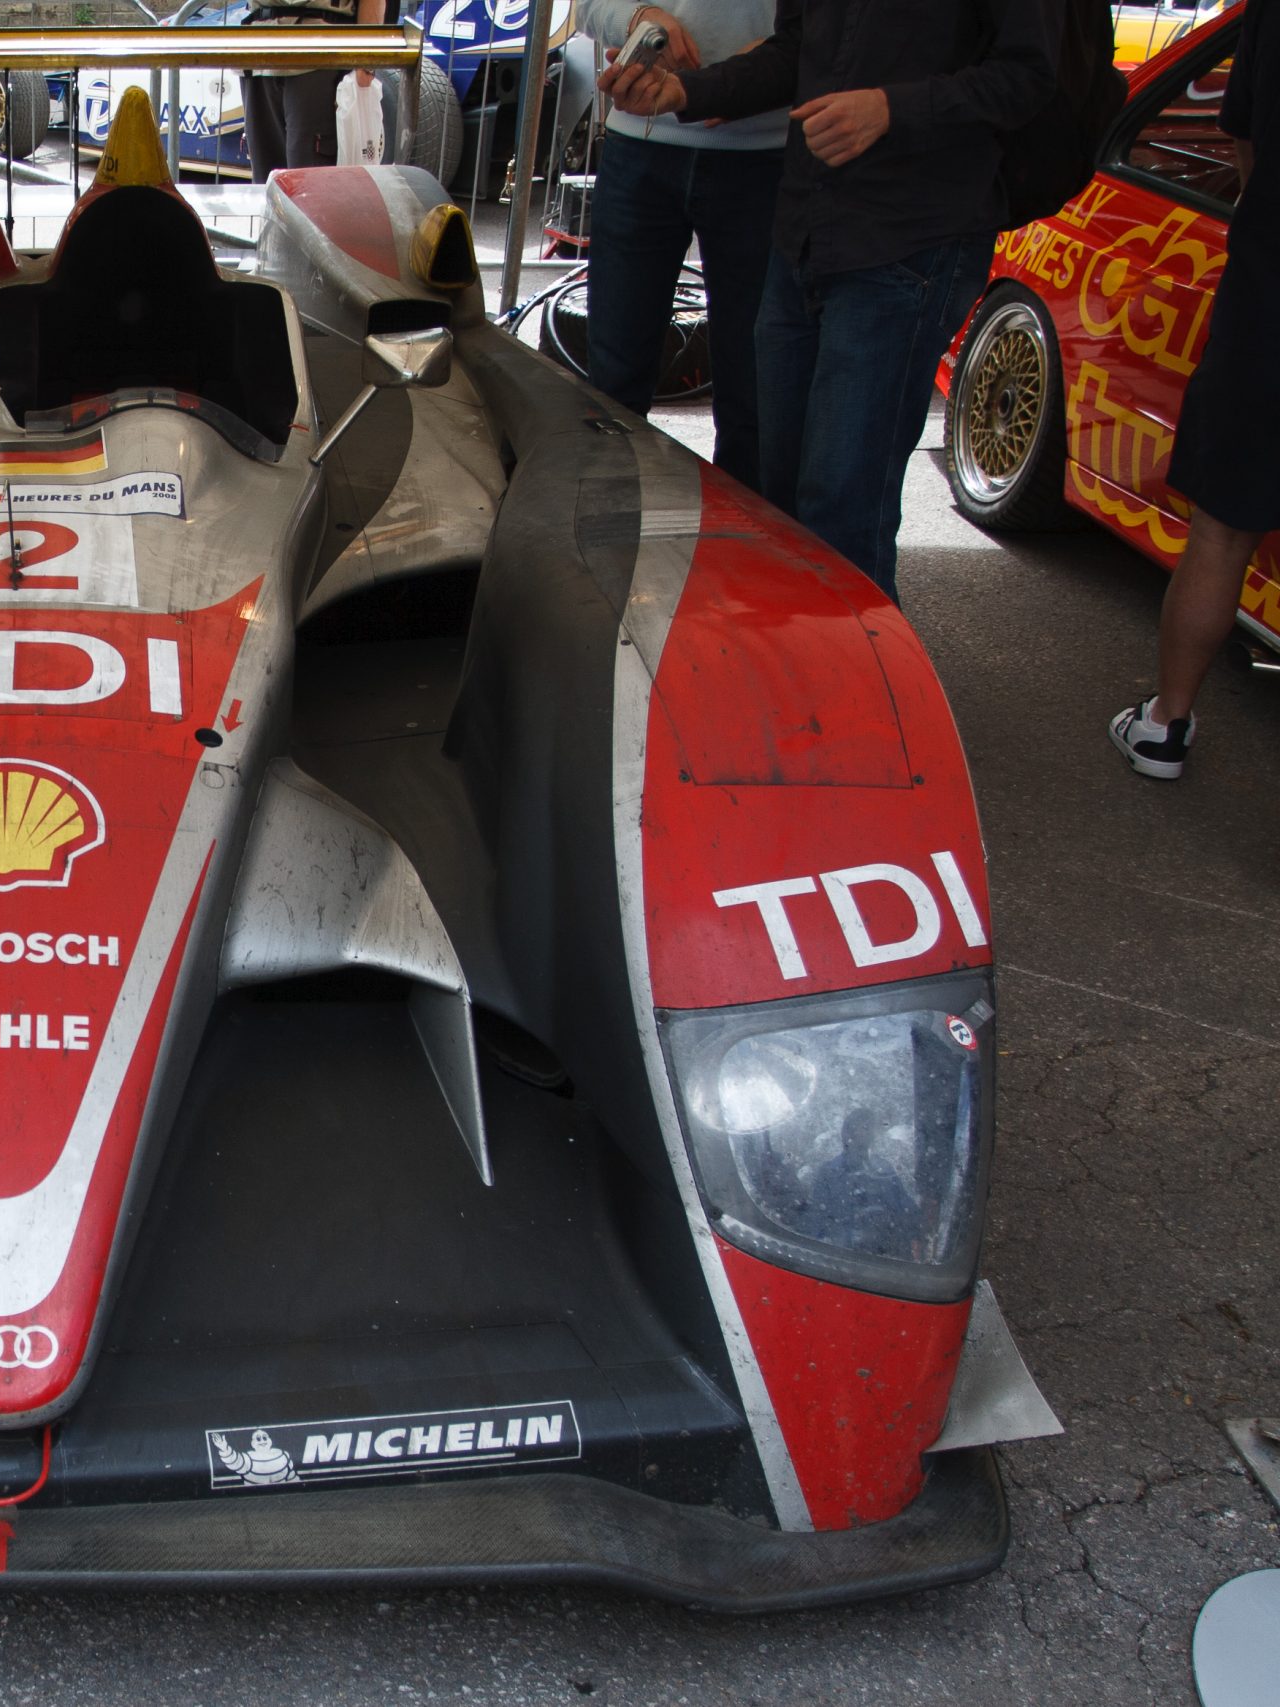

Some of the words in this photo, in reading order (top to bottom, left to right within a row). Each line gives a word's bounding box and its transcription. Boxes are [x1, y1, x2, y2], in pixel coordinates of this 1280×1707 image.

[13, 493, 82, 503] HEURES
[88, 490, 115, 501] DU
[121, 482, 177, 497] MANS
[152, 492, 177, 500] 2008
[712, 850, 987, 980] TDI
[301, 1415, 563, 1464] MICHELIN
